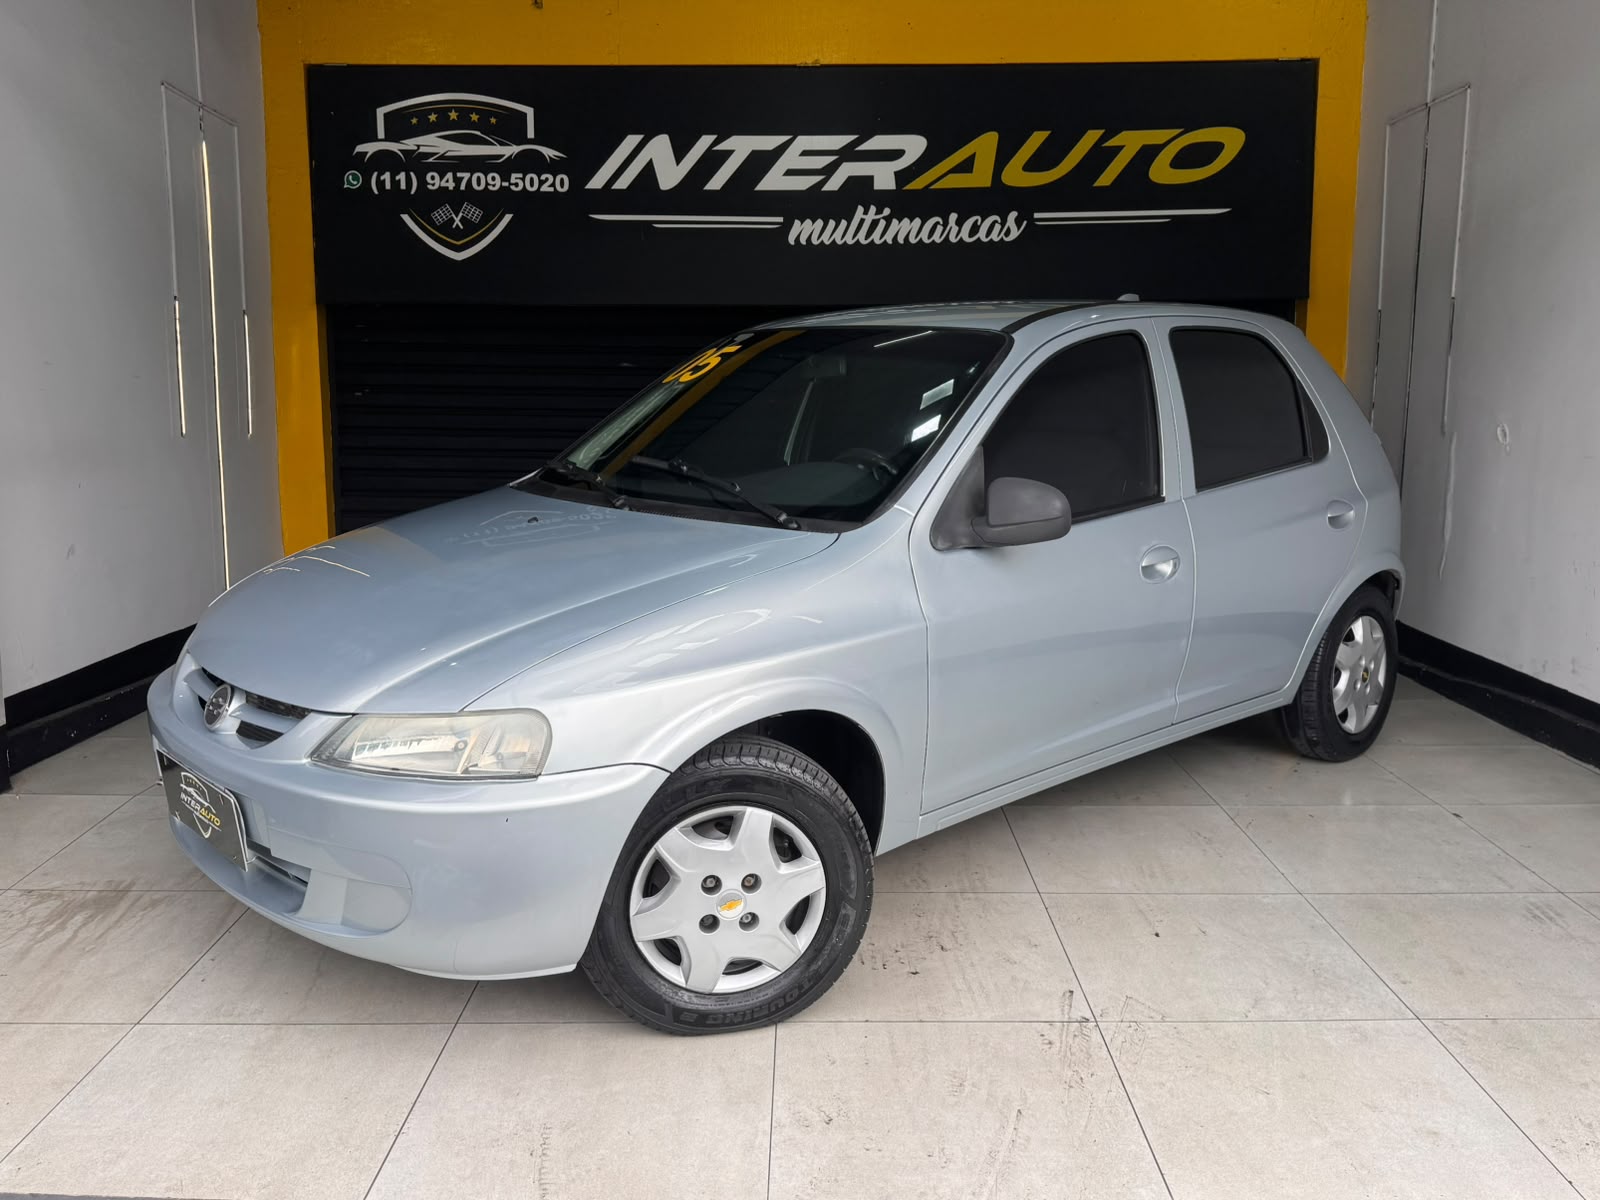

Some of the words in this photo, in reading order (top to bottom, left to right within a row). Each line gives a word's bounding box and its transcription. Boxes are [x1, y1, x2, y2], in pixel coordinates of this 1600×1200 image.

[584, 126, 1246, 191] INTERAUTO
[370, 170, 418, 195] (11)
[426, 171, 570, 193] 94709-5020
[787, 204, 1028, 246] multimarcas
[180, 792, 221, 827] INTERAUTO
